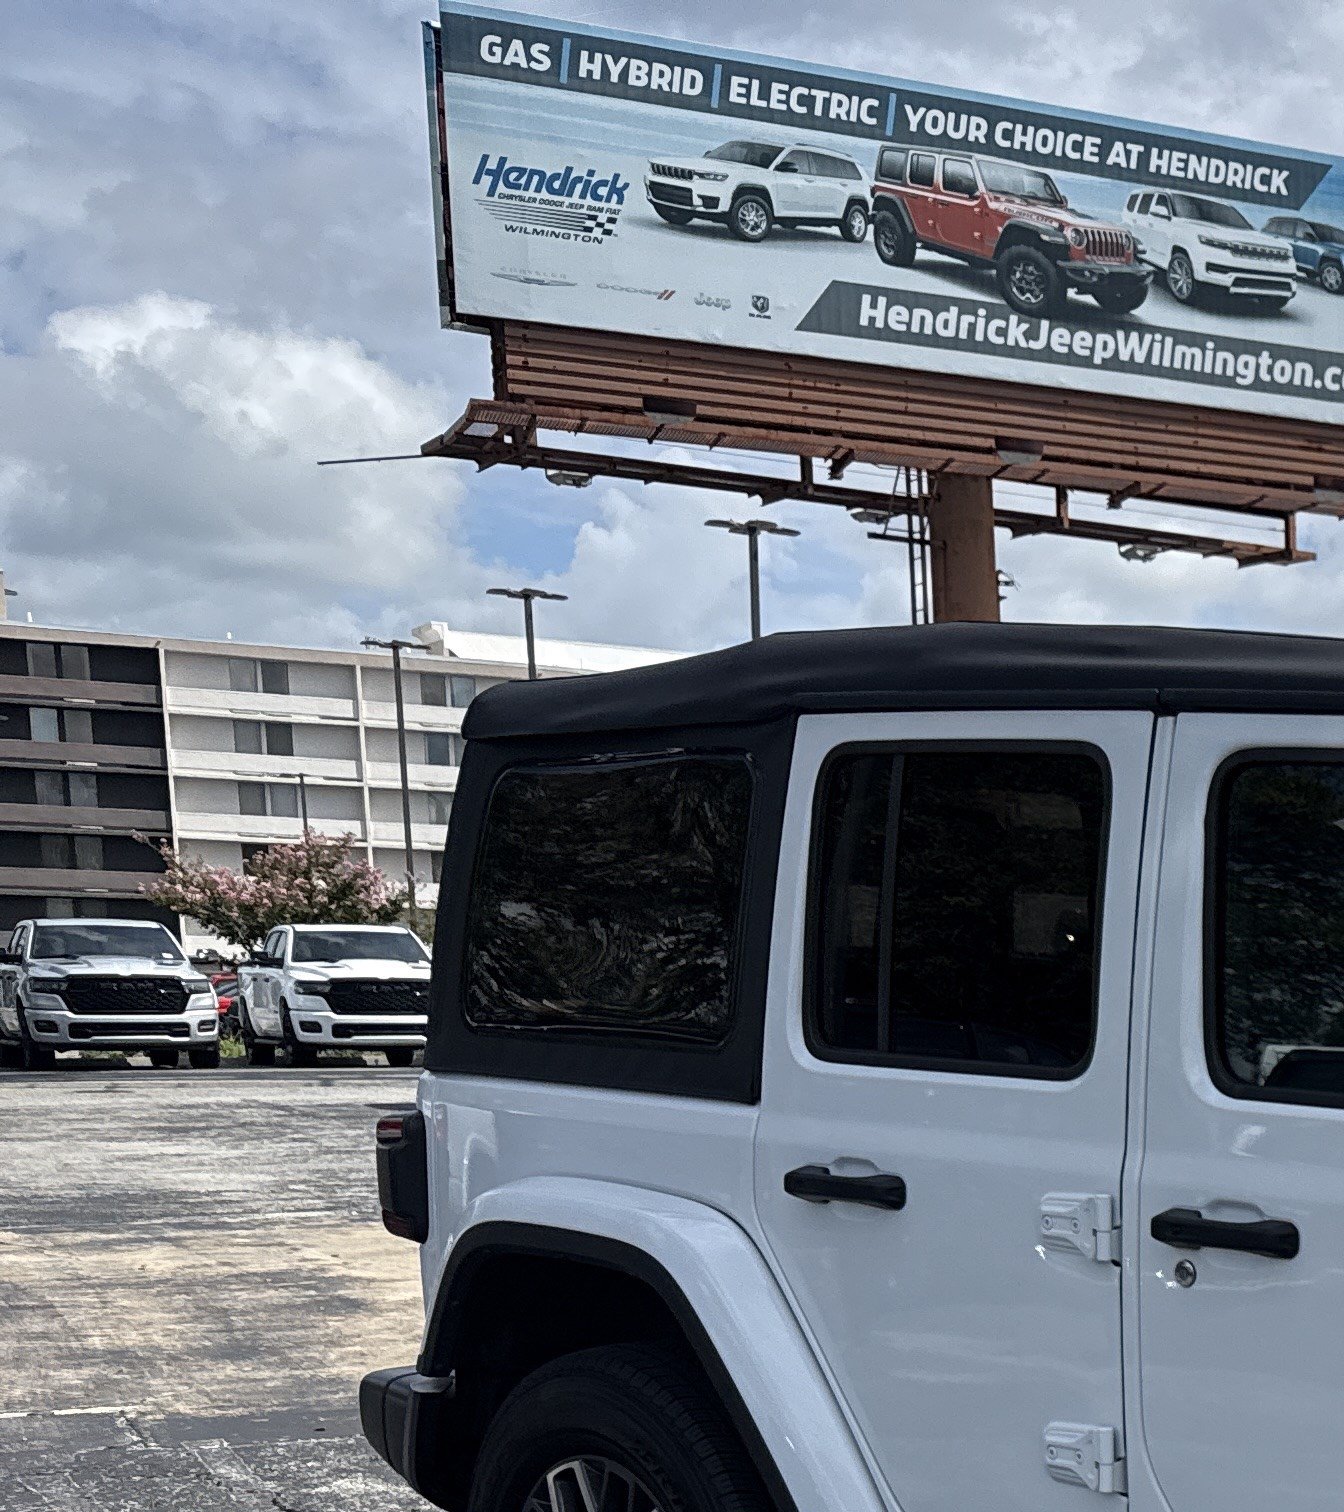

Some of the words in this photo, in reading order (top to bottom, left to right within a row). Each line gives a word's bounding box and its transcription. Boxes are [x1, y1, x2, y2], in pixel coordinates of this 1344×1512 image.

[480, 34, 552, 72] GAS
[578, 49, 704, 96] HYBRID
[728, 75, 880, 126] ELECTRIC
[903, 104, 988, 144] YOUR
[994, 120, 1102, 163] CHOICE
[1106, 141, 1145, 170] AT
[1147, 147, 1290, 196] HENDRICK
[472, 153, 630, 205] Hendrick
[565, 201, 585, 211] JEEP
[604, 206, 622, 216] FIAT
[504, 223, 604, 245] WILMINGTON
